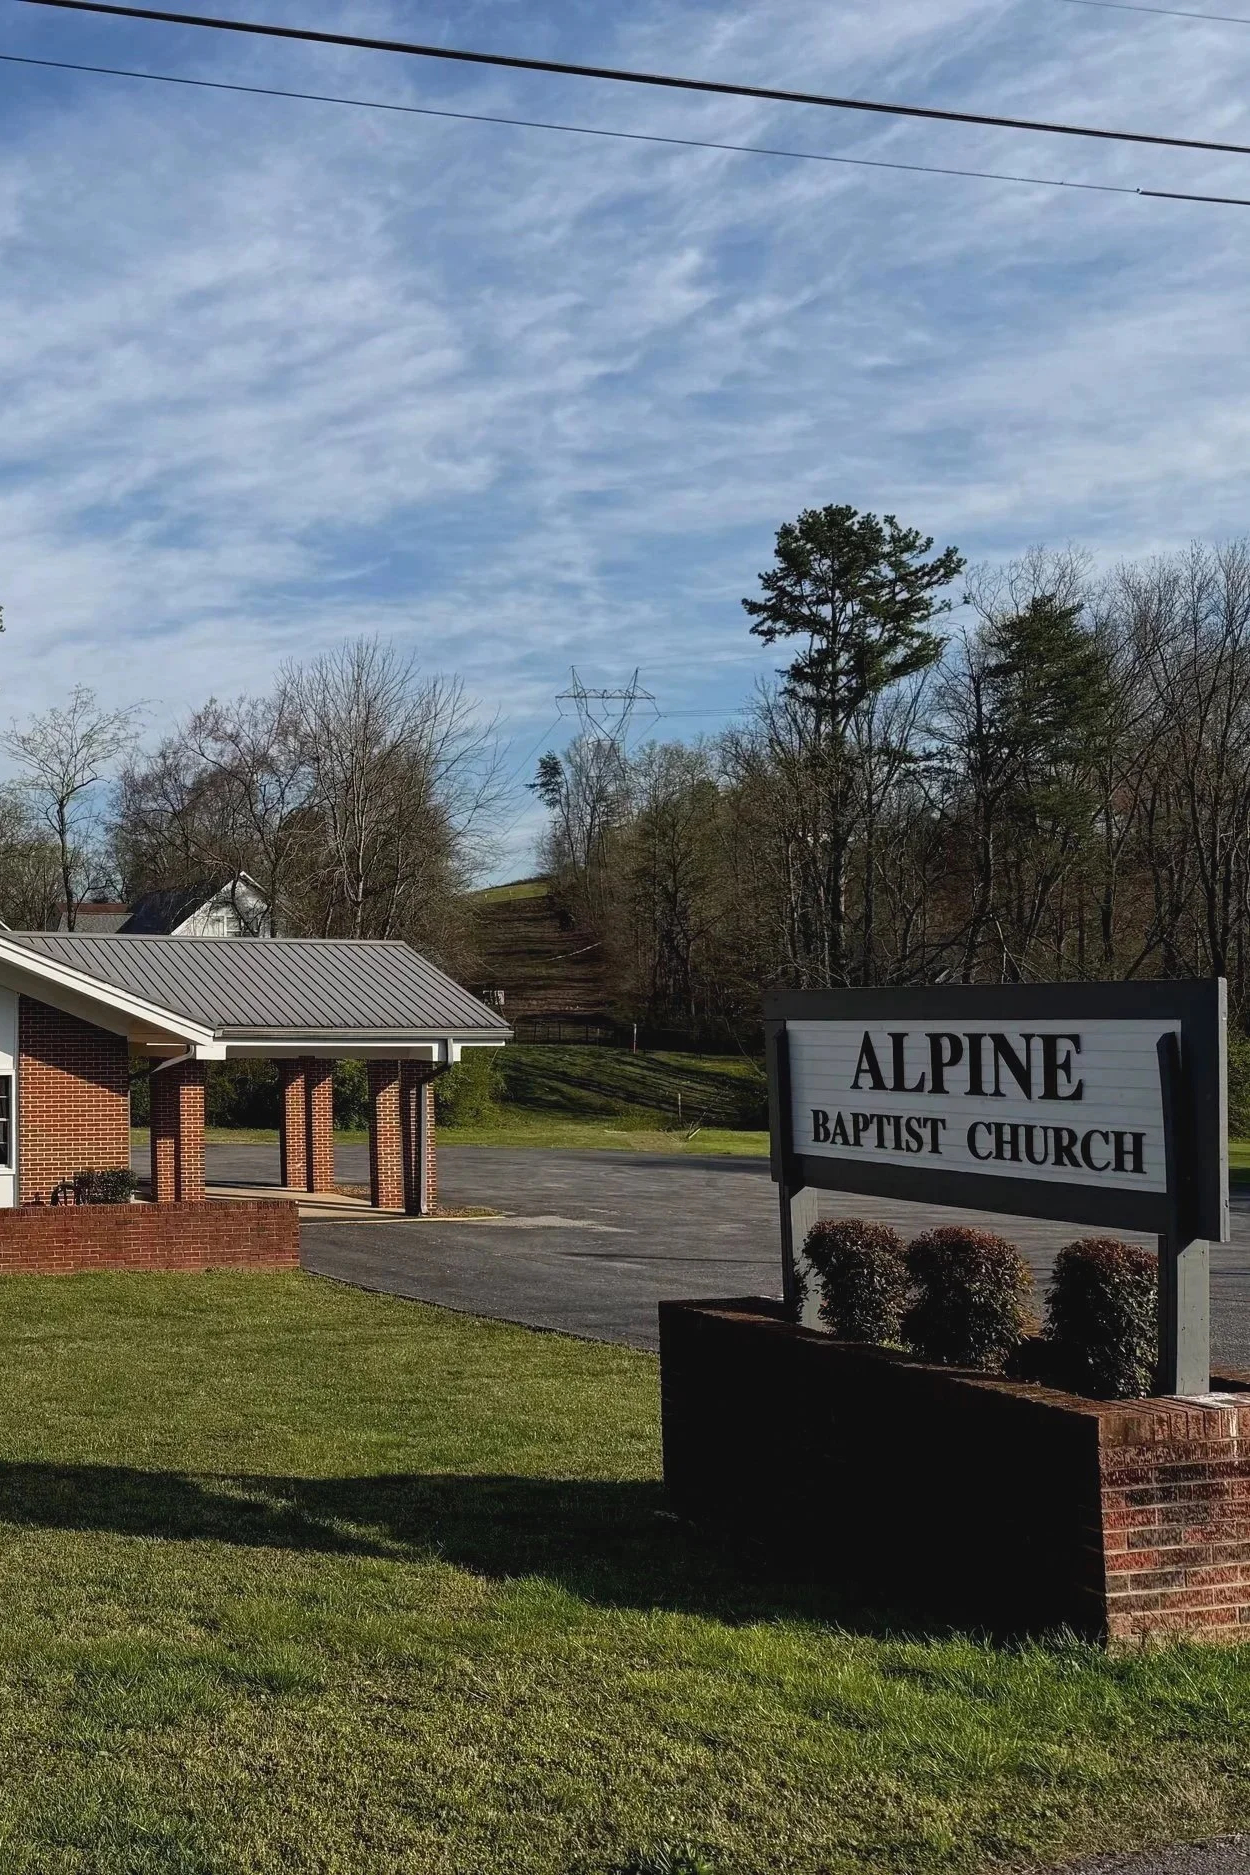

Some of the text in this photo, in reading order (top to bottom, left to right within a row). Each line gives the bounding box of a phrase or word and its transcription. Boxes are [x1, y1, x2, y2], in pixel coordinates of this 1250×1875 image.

[850, 1031, 1083, 1100] ALPINE
[810, 1109, 1147, 1174] BAPTIST CHURCH
